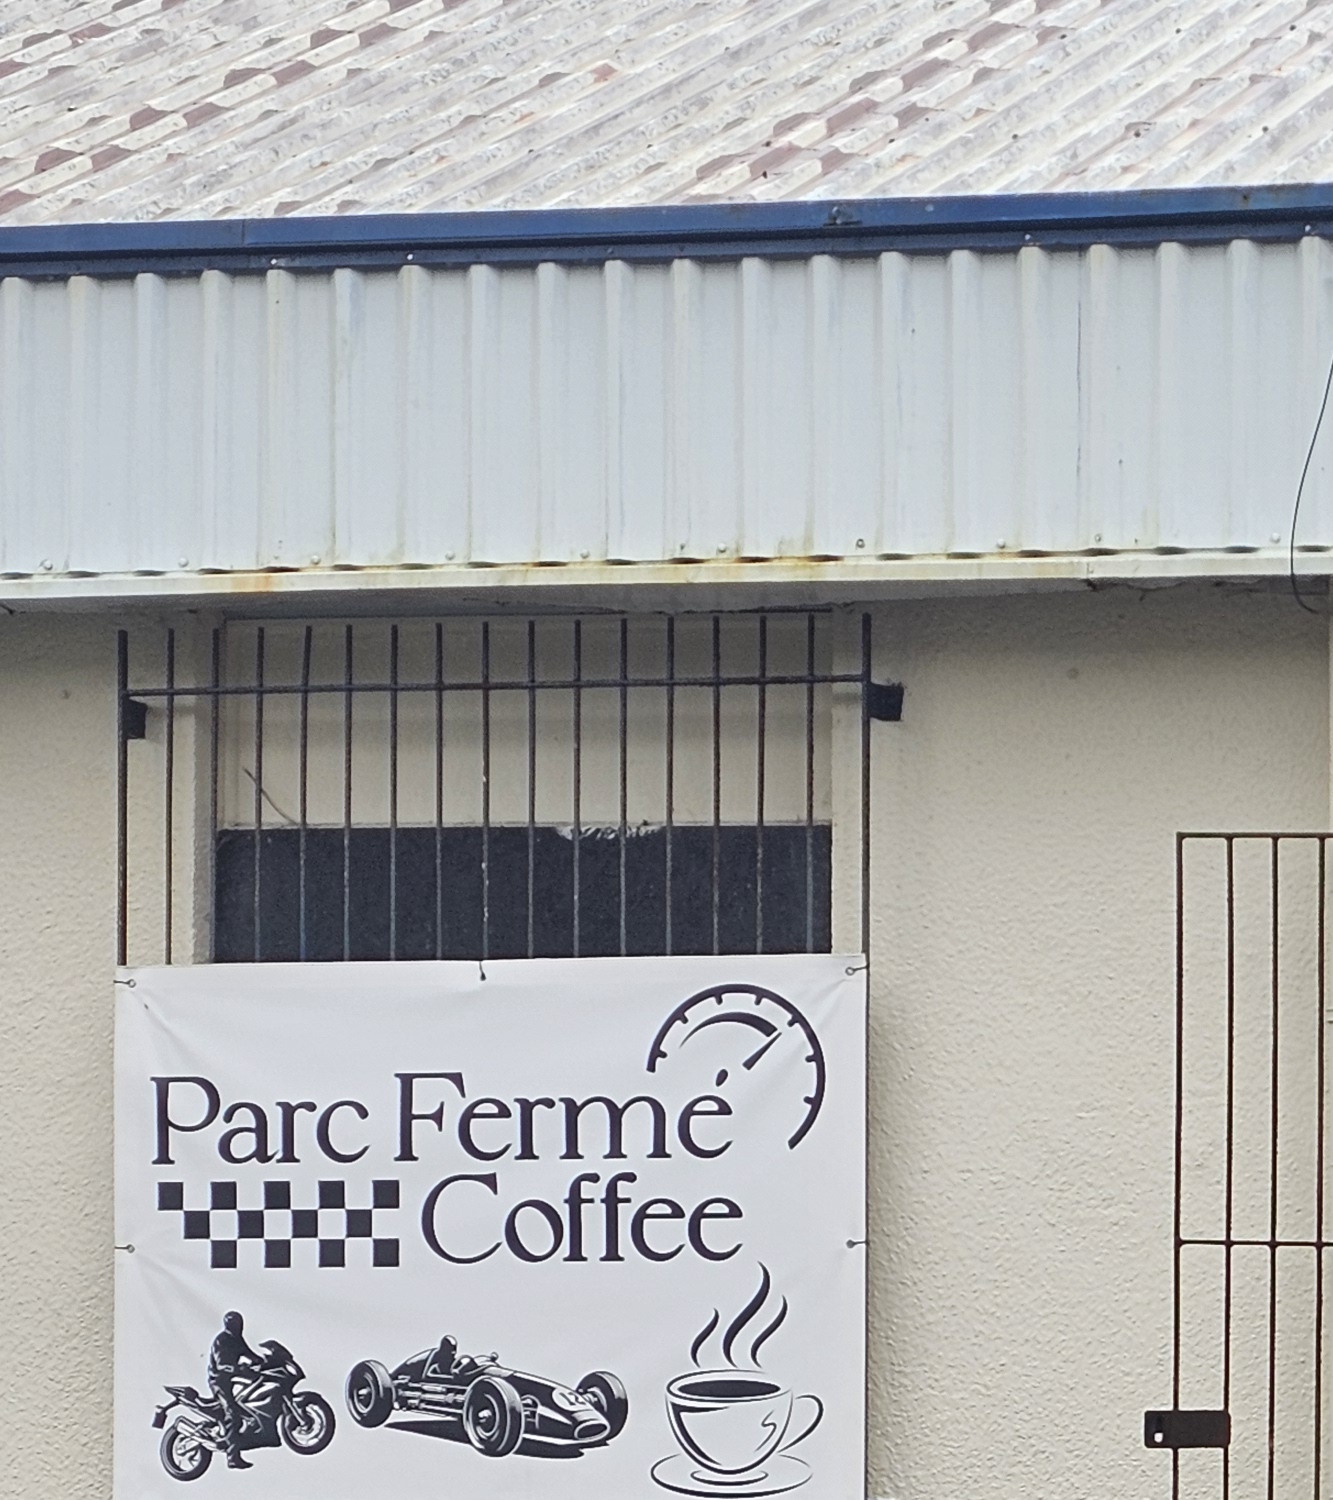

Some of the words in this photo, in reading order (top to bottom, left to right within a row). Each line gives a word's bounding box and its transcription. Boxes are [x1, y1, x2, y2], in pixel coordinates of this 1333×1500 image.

[150, 1075, 371, 1165] Parc
[394, 1067, 735, 1162] Fermé
[421, 1171, 744, 1264] Coffee
